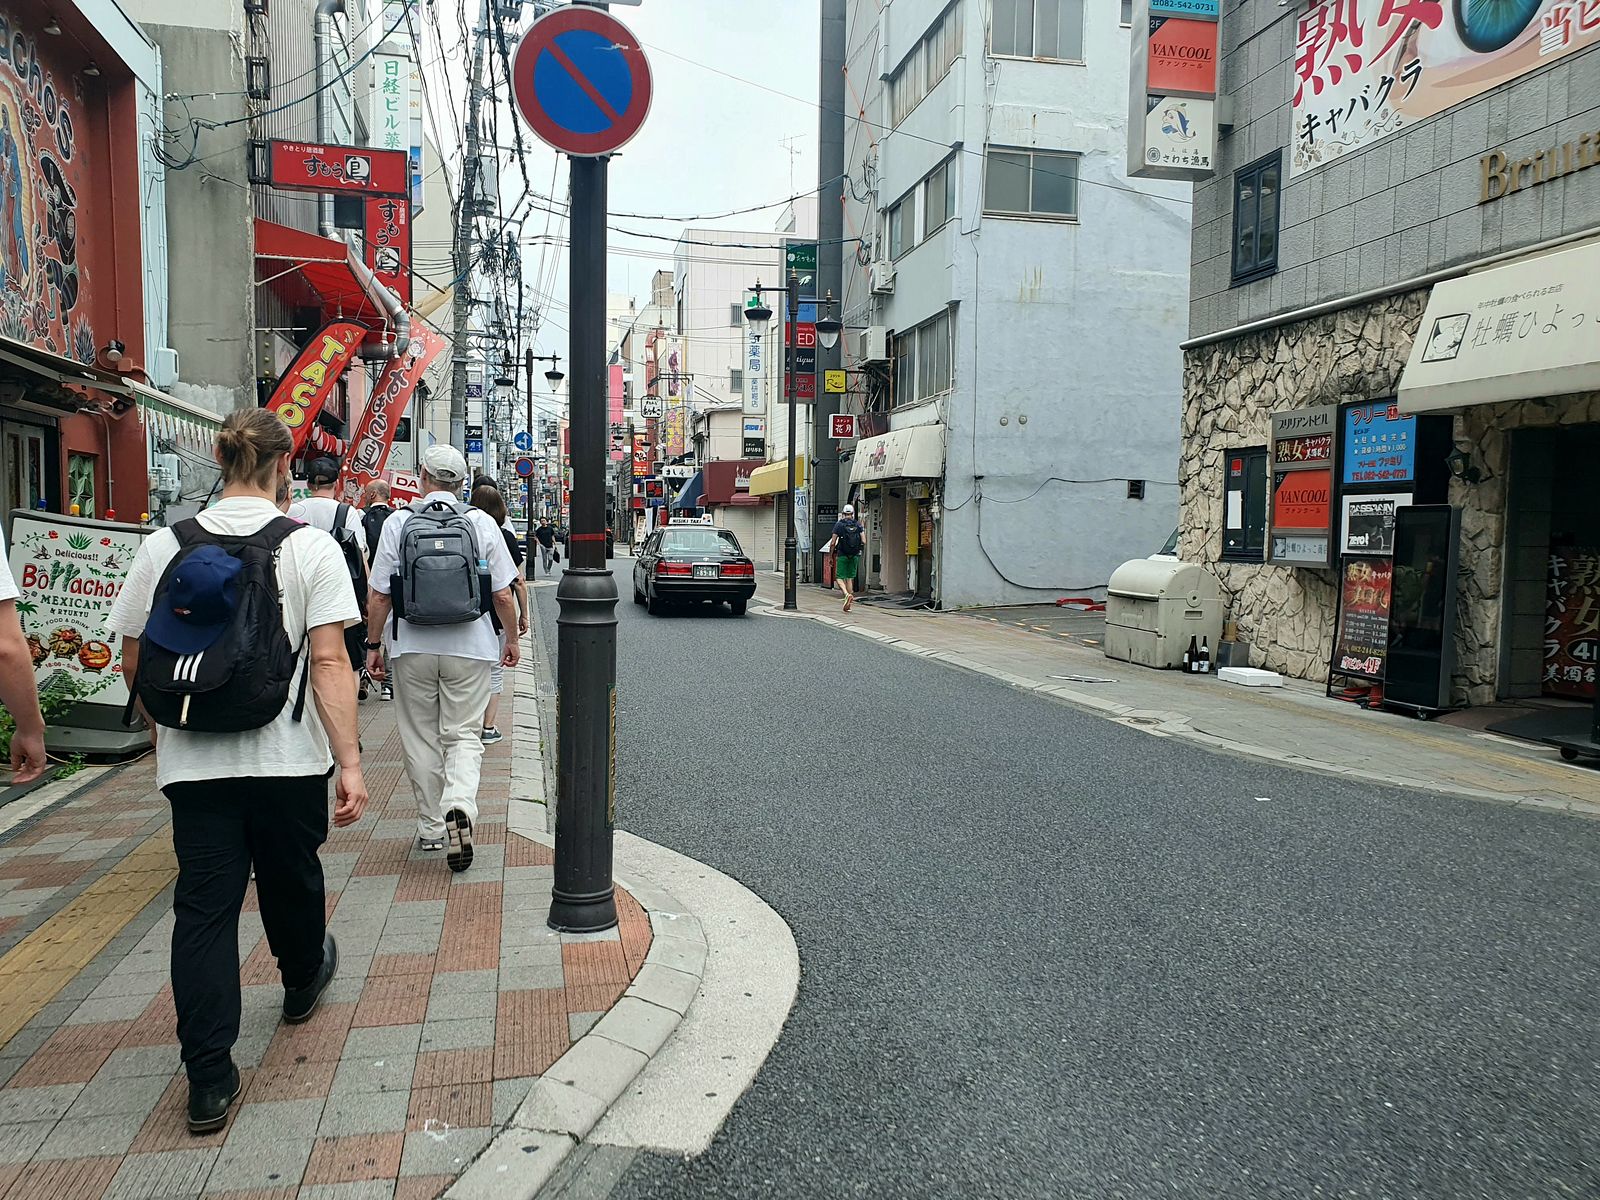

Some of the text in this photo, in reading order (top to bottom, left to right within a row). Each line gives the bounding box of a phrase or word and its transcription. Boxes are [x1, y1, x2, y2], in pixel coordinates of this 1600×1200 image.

[1150, 20, 1161, 28] 2F
[1158, 59, 1203, 69] ヴァンクール
[1300, 58, 1422, 144] キャバクラ
[1471, 303, 1600, 350] 牡蠣ひよっ
[276, 336, 345, 428] TACO
[835, 424, 852, 434] 花月
[1278, 413, 1329, 431] ブリリアントビル
[1276, 474, 1284, 483] 2F
[55, 548, 99, 561] Delicious!!
[40, 594, 102, 610] MEXICAN
[1543, 554, 1568, 659] キャバクラ
[45, 617, 63, 626] FOOD
[70, 618, 90, 631] DRINK
